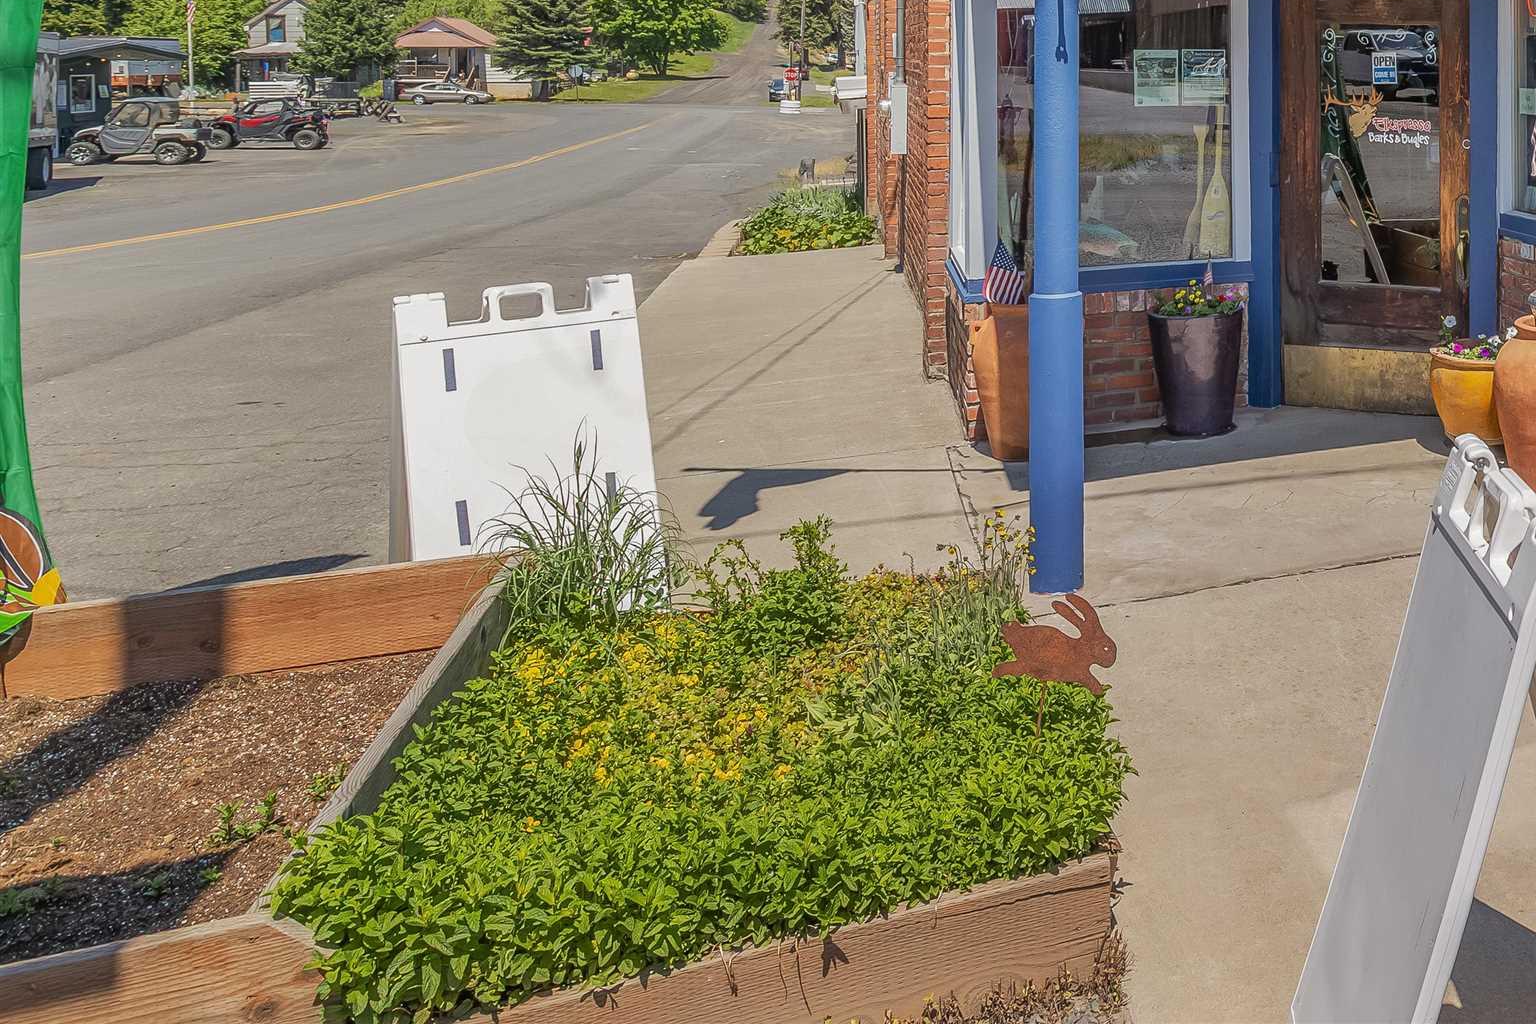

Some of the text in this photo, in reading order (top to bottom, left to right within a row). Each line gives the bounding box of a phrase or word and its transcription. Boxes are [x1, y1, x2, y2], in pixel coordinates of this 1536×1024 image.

[1374, 56, 1395, 66] OPEN
[1372, 117, 1431, 133] Elkspresso
[1368, 132, 1393, 144] Barks
[1401, 132, 1430, 148] Bugles
